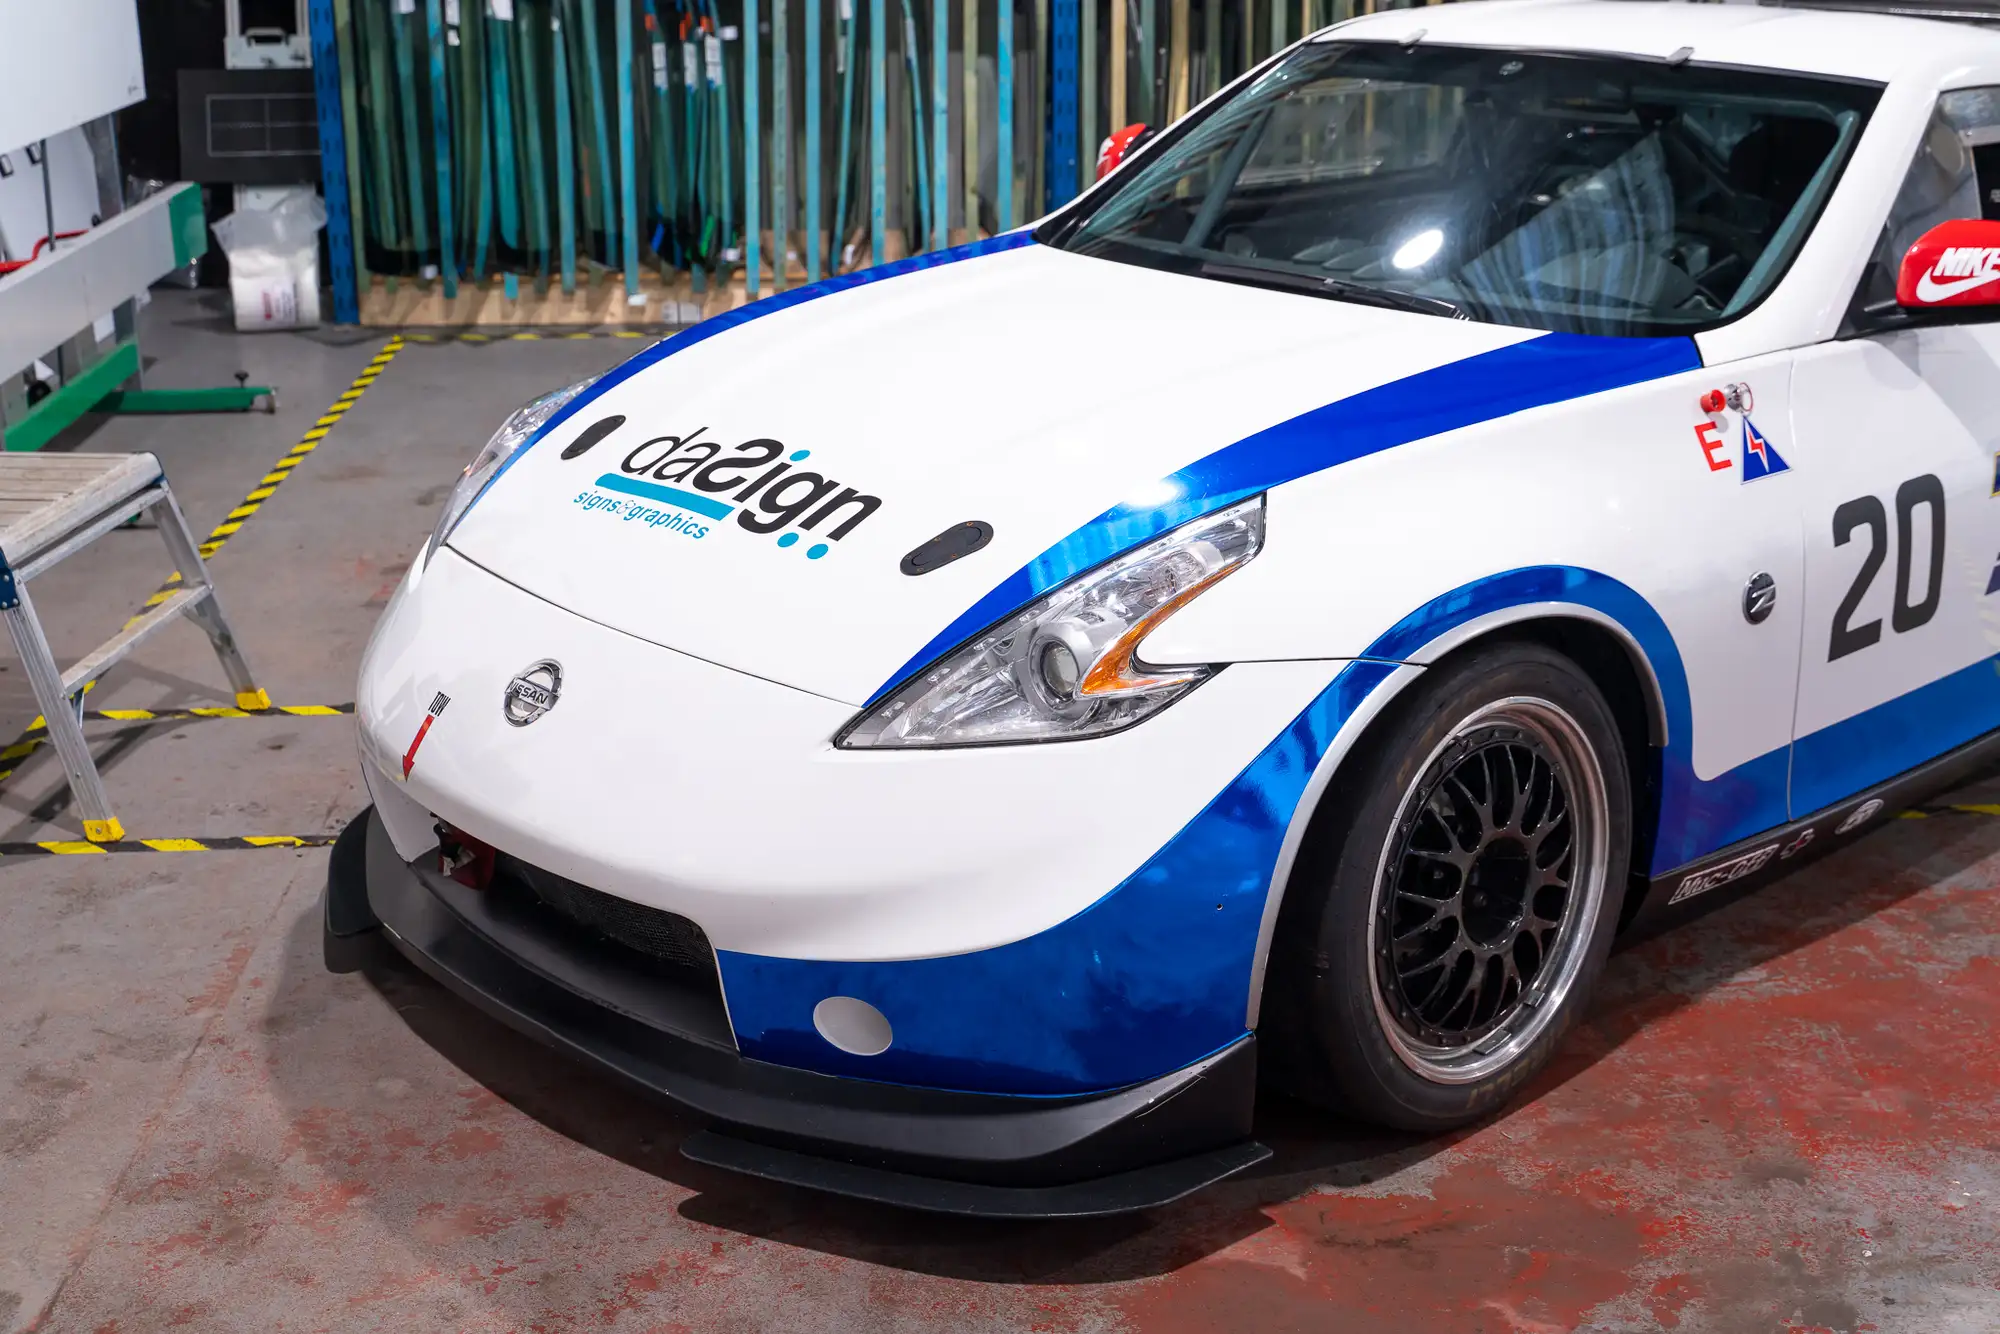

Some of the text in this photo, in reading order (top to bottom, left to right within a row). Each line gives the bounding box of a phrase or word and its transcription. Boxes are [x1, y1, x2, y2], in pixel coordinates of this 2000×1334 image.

[1932, 247, 2000, 278] NIKE
[1694, 420, 1733, 472] E
[1827, 473, 1946, 663] 20
[428, 691, 451, 717] TOW
